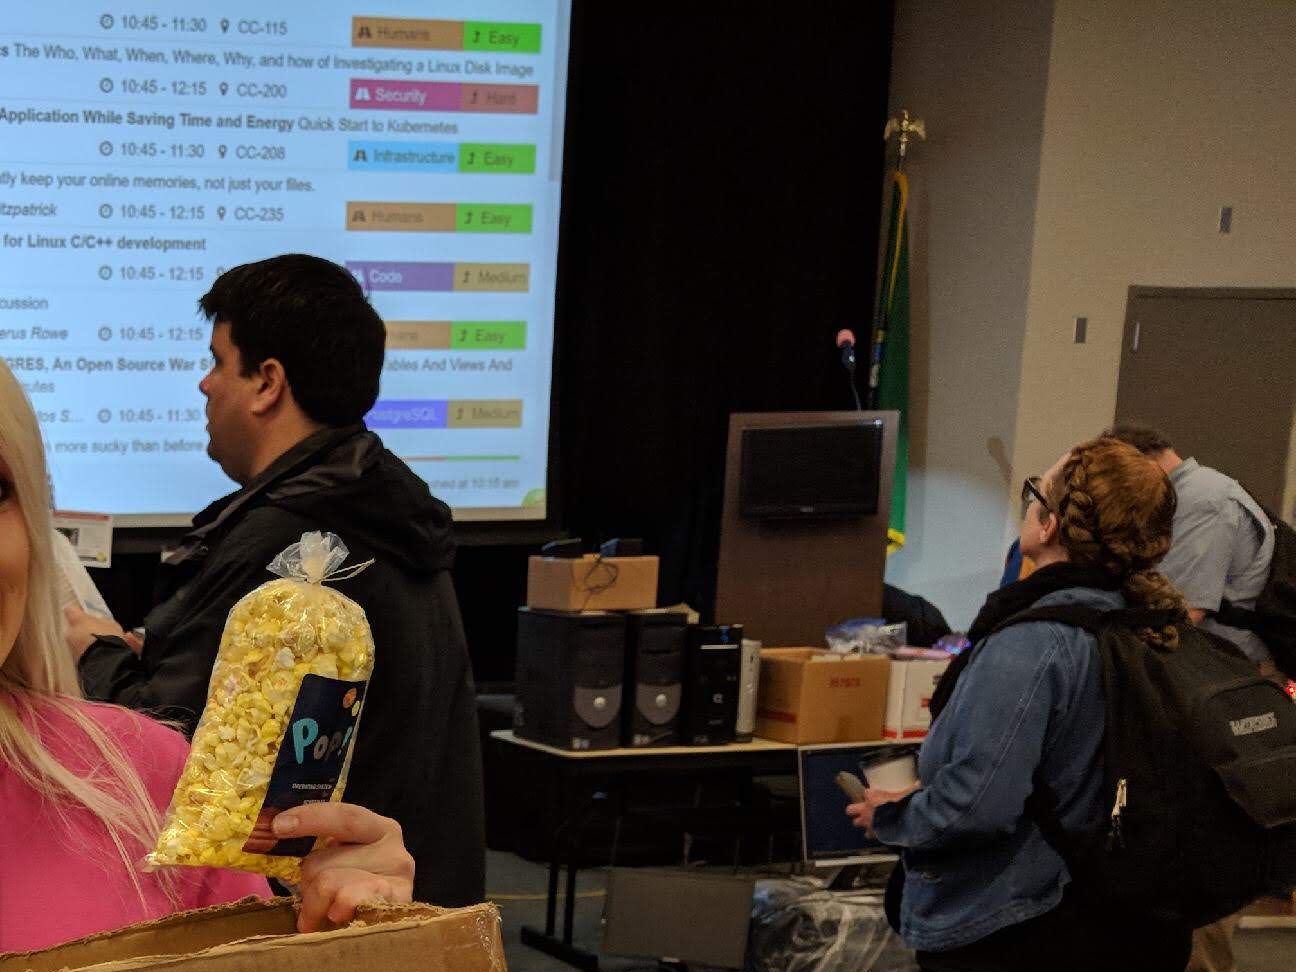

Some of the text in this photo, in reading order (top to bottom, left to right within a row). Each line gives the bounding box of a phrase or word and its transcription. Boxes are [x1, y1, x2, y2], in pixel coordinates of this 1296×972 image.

[122, 15, 158, 30] 10:45
[171, 18, 207, 32] 11:30
[238, 20, 287, 35] CC-115
[377, 26, 430, 42] Humans
[488, 31, 519, 47] Easy
[14, 43, 40, 58] The
[44, 45, 79, 61] Who,
[83, 46, 122, 62] What,
[126, 48, 168, 64] When,
[172, 50, 218, 66] Where,
[223, 51, 255, 69] Why,
[259, 54, 284, 68] and
[287, 54, 314, 69] how
[317, 55, 330, 69] of
[334, 56, 412, 76] Investigating
[428, 58, 461, 74] Linux
[464, 60, 492, 75] Disk
[496, 62, 534, 79] Image
[121, 79, 158, 95] 10:45
[171, 81, 207, 96] 12:15
[236, 83, 287, 99] CC-200
[375, 88, 427, 106] Security
[83, 110, 122, 125] While
[127, 111, 175, 129] Saving
[179, 112, 212, 128] Time
[216, 114, 242, 128] and
[247, 115, 295, 133] Energy
[298, 116, 334, 131] Quick
[338, 117, 367, 132] Start
[372, 118, 384, 133] to
[387, 119, 459, 135] Kubernetes
[121, 142, 157, 157] 10:45
[170, 144, 205, 158] 11:30
[235, 145, 285, 160] CC-208
[373, 148, 456, 164] Infrastructure
[483, 151, 515, 168] Easy
[20, 172, 53, 189] keep
[57, 175, 86, 190] your
[89, 172, 128, 188] online
[132, 174, 201, 192] memories,
[205, 177, 223, 190] not
[227, 177, 250, 194] just
[252, 180, 283, 195] your
[286, 177, 315, 192] files.
[120, 204, 156, 219] 10:45
[169, 206, 204, 220] 12:15
[234, 206, 284, 222] CC-235
[372, 209, 424, 224] Humans
[480, 211, 511, 228] Easy
[3, 234, 22, 248] for
[27, 234, 67, 249] Linux
[70, 235, 112, 250] C/C++
[117, 236, 206, 252] development
[120, 266, 155, 280] 10:45
[169, 267, 204, 281] 12:15
[369, 269, 402, 284] Code
[478, 270, 527, 285] Medium
[30, 326, 68, 340] Rowe
[120, 327, 154, 341] 10:45
[168, 327, 203, 341] 12:15
[475, 329, 505, 344] Easy
[53, 357, 72, 370] An
[76, 357, 113, 374] Open
[117, 358, 165, 371] Source
[169, 358, 196, 371] War
[421, 358, 447, 371] And
[450, 357, 485, 371] Views
[488, 358, 513, 371] And
[119, 409, 154, 423] 10:45
[167, 409, 200, 422] 11:30
[471, 406, 519, 421] Medium
[131, 439, 160, 451] than
[164, 439, 203, 451] before
